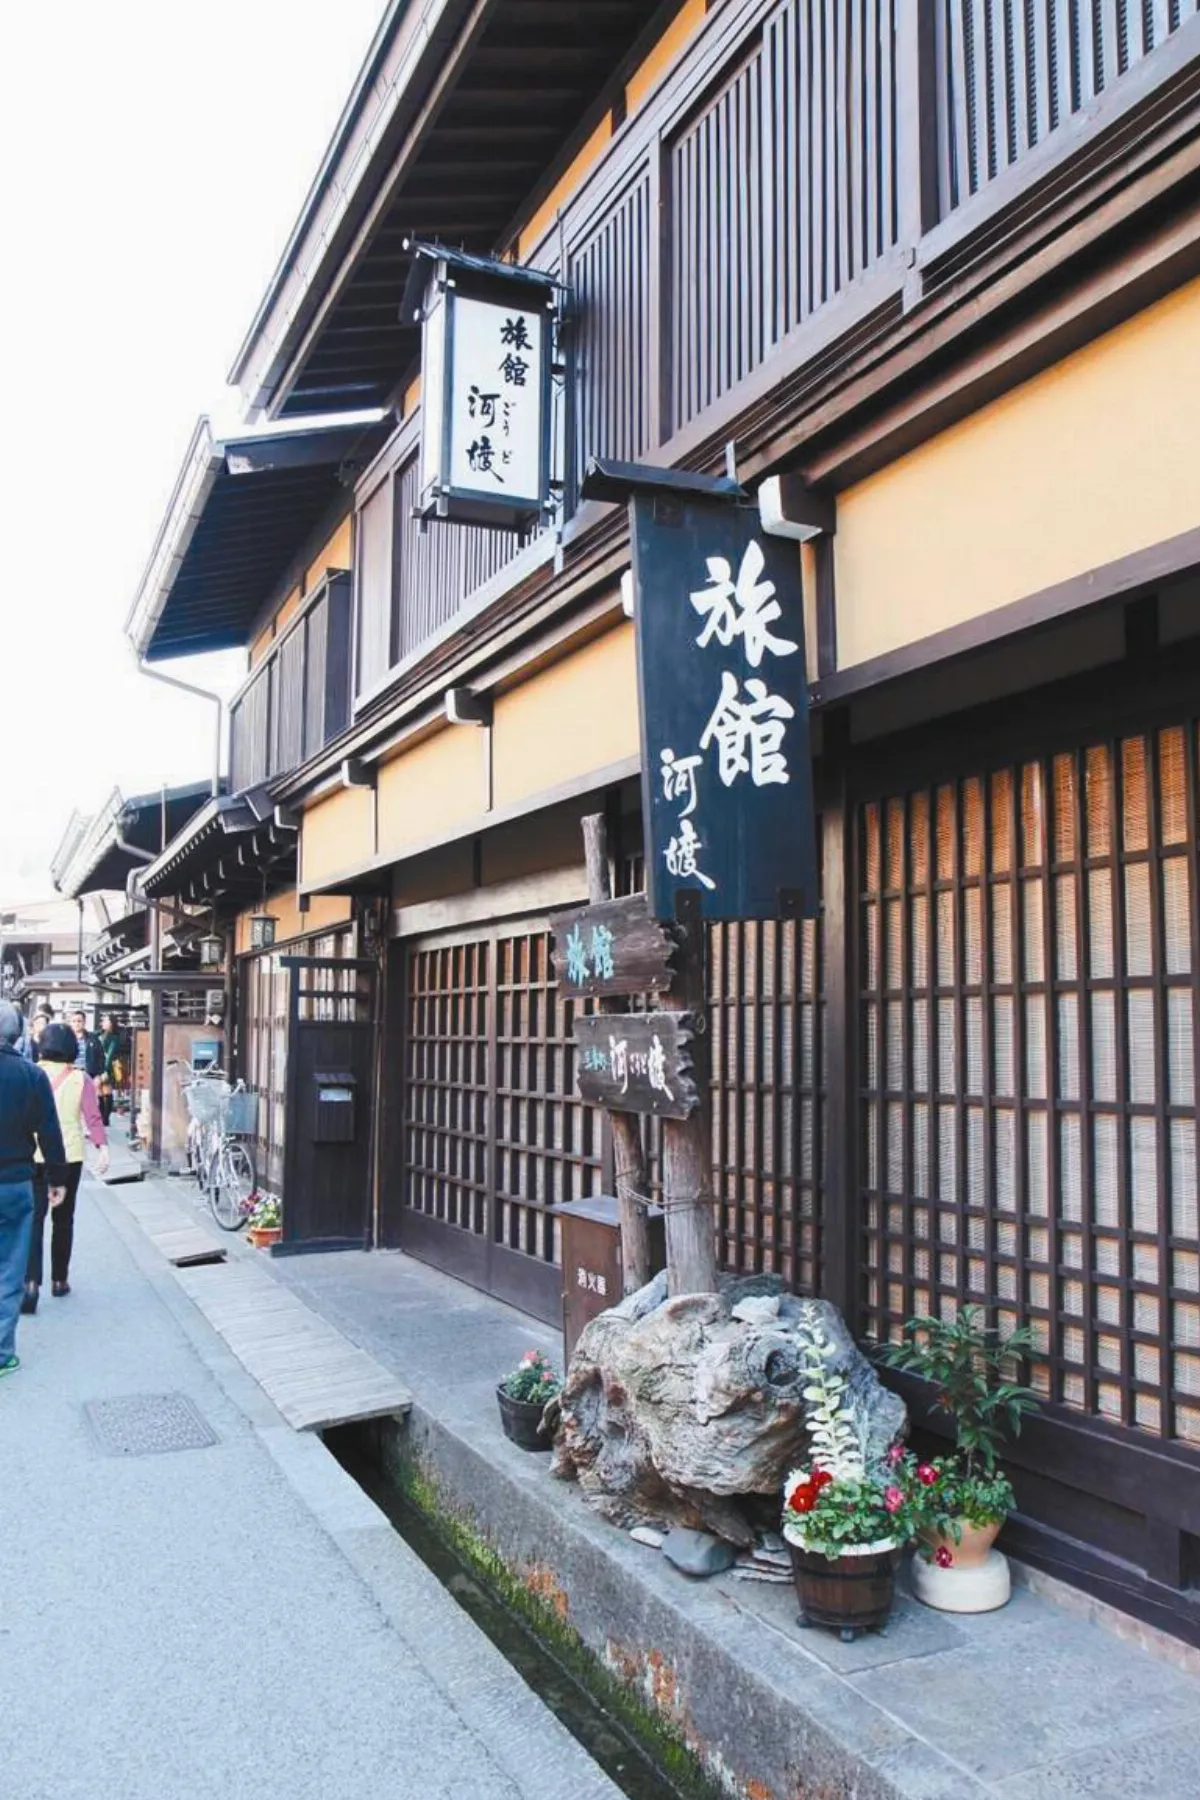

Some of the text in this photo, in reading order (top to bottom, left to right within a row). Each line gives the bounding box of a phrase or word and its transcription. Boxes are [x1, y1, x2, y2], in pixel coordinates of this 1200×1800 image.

[499, 316, 533, 387] 旅館
[502, 401, 516, 464] ごうど
[689, 539, 799, 788] 旅館
